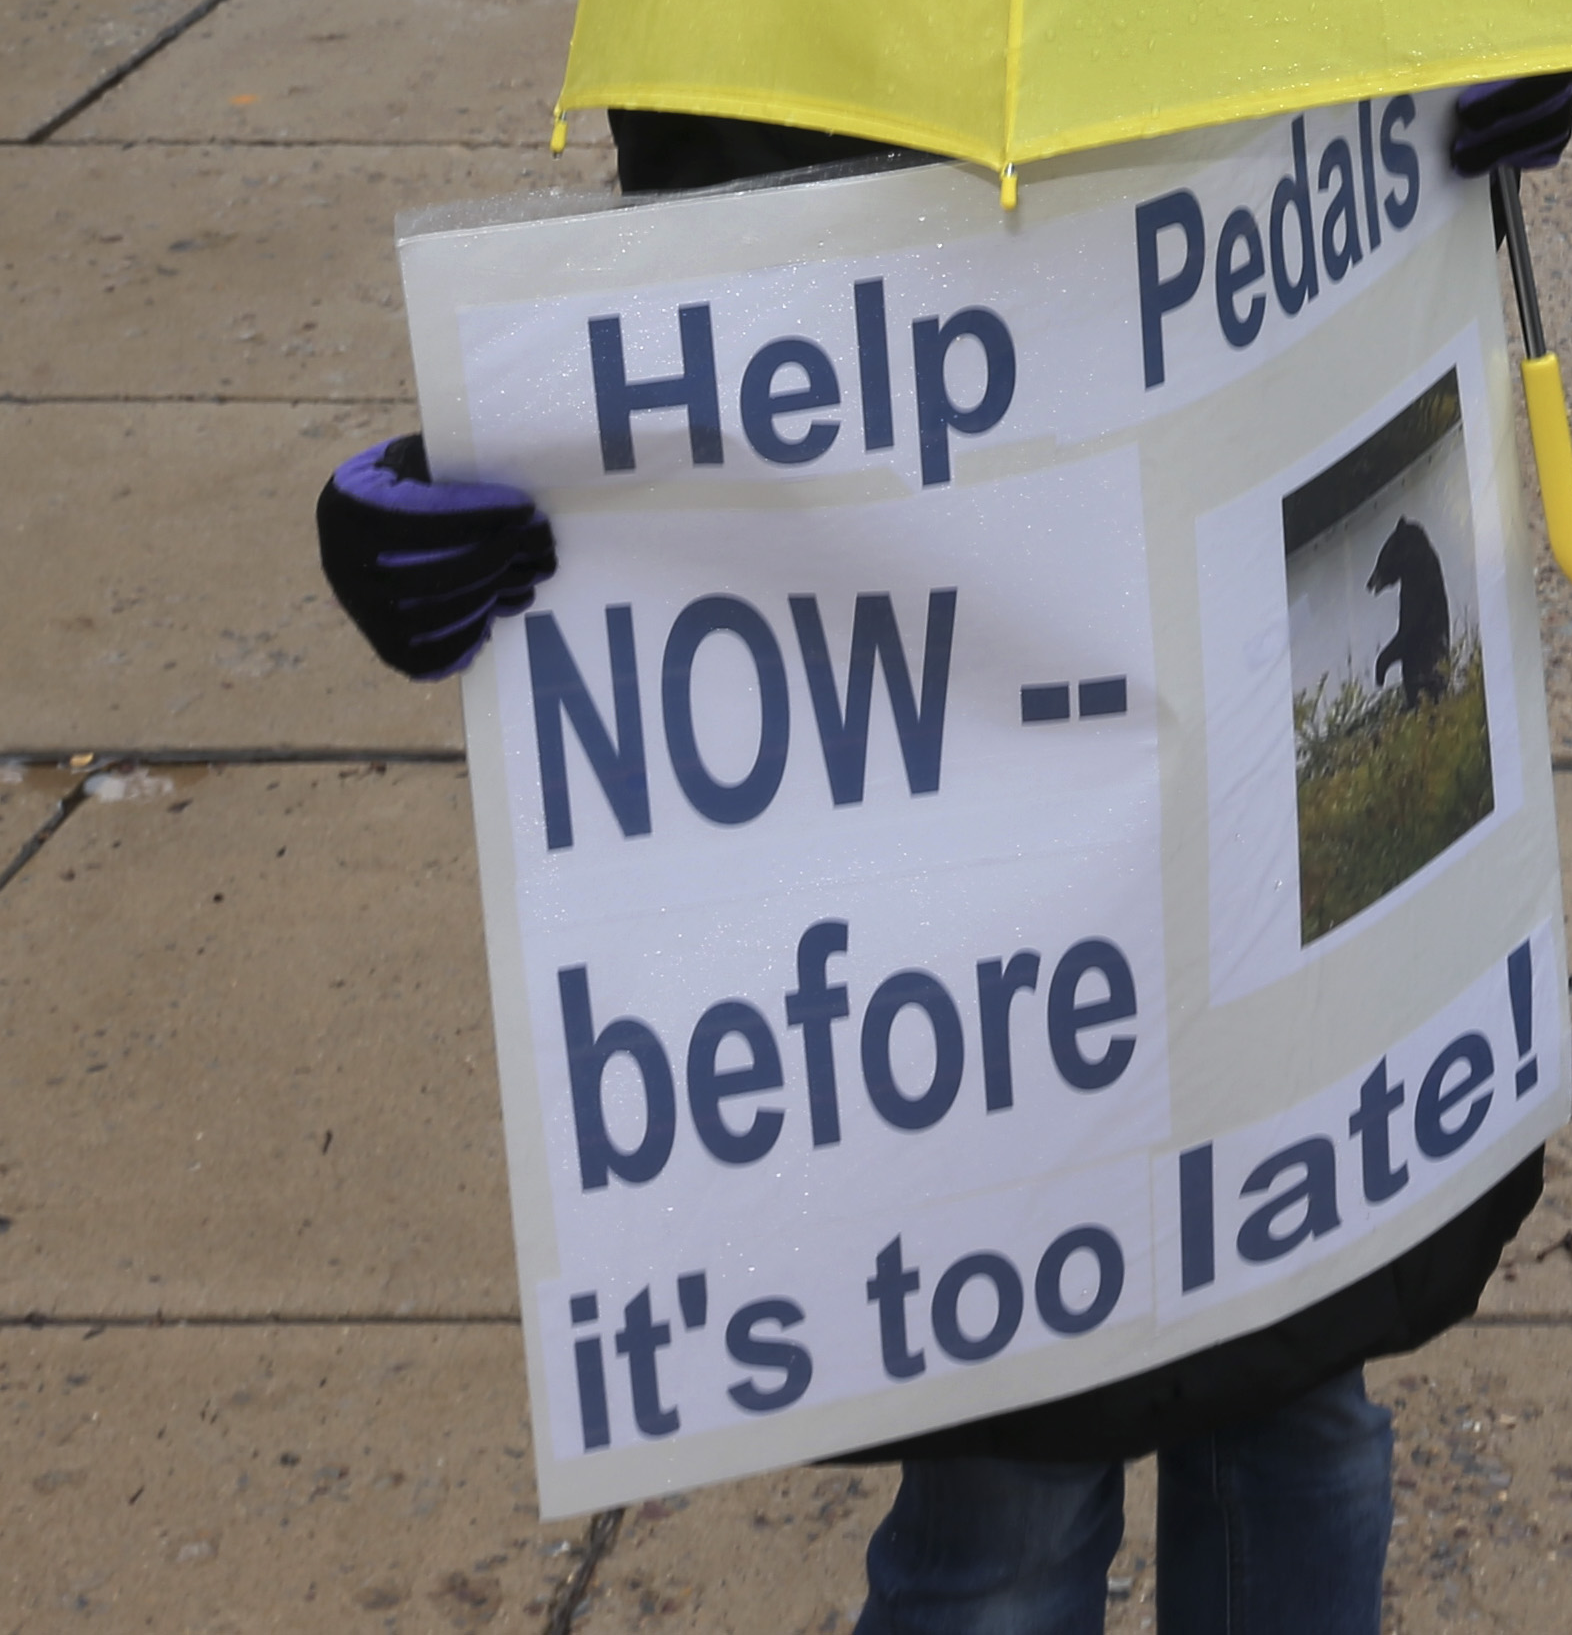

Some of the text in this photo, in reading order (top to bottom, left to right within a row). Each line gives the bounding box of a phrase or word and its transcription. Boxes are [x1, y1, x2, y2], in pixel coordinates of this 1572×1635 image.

[587, 91, 1421, 488] Help Pedals
[523, 587, 959, 853] NOW
[556, 919, 1140, 1193] before
[568, 937, 1540, 1452] it's too late!
